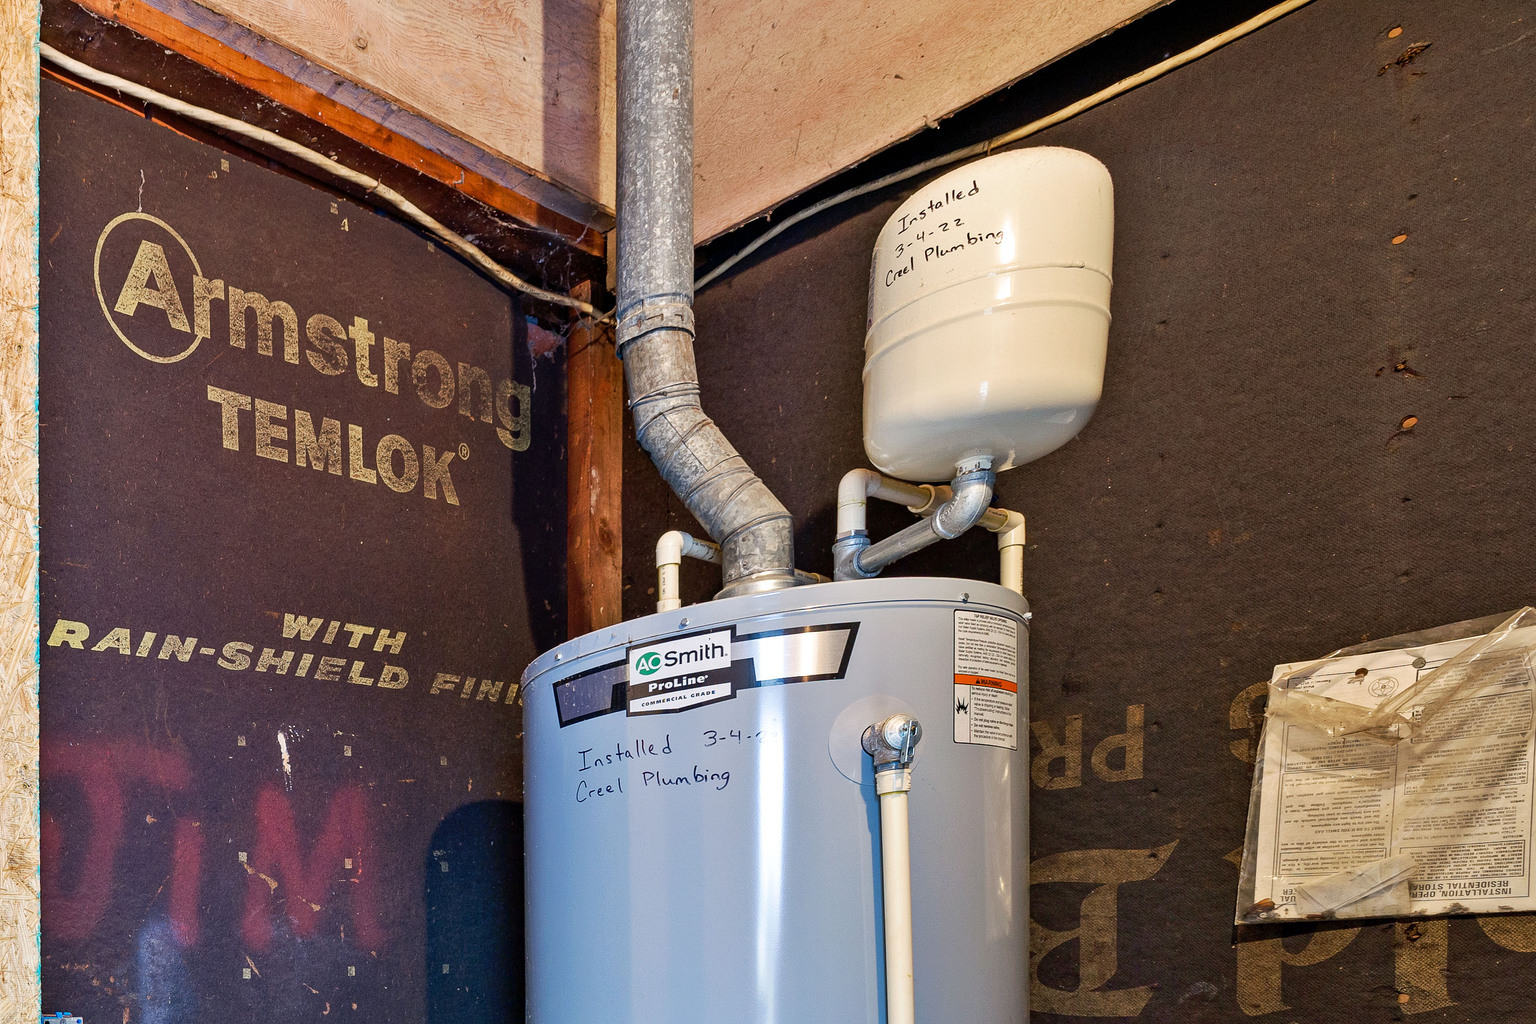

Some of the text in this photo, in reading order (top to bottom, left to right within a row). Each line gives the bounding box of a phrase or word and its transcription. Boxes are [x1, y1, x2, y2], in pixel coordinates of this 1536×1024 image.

[898, 180, 979, 234] Installed
[925, 231, 1004, 262] Plumbing
[114, 239, 531, 452] Armstrong
[281, 613, 407, 655] WITH
[47, 619, 523, 707] RAIN-SHIELD FINI
[664, 643, 724, 667] Smith
[642, 690, 716, 707] COMMERCIAL GRADE
[578, 734, 672, 772] Installed
[576, 766, 731, 803] Creel Plumbing
[1447, 880, 1509, 889] RESIDENTIAL
